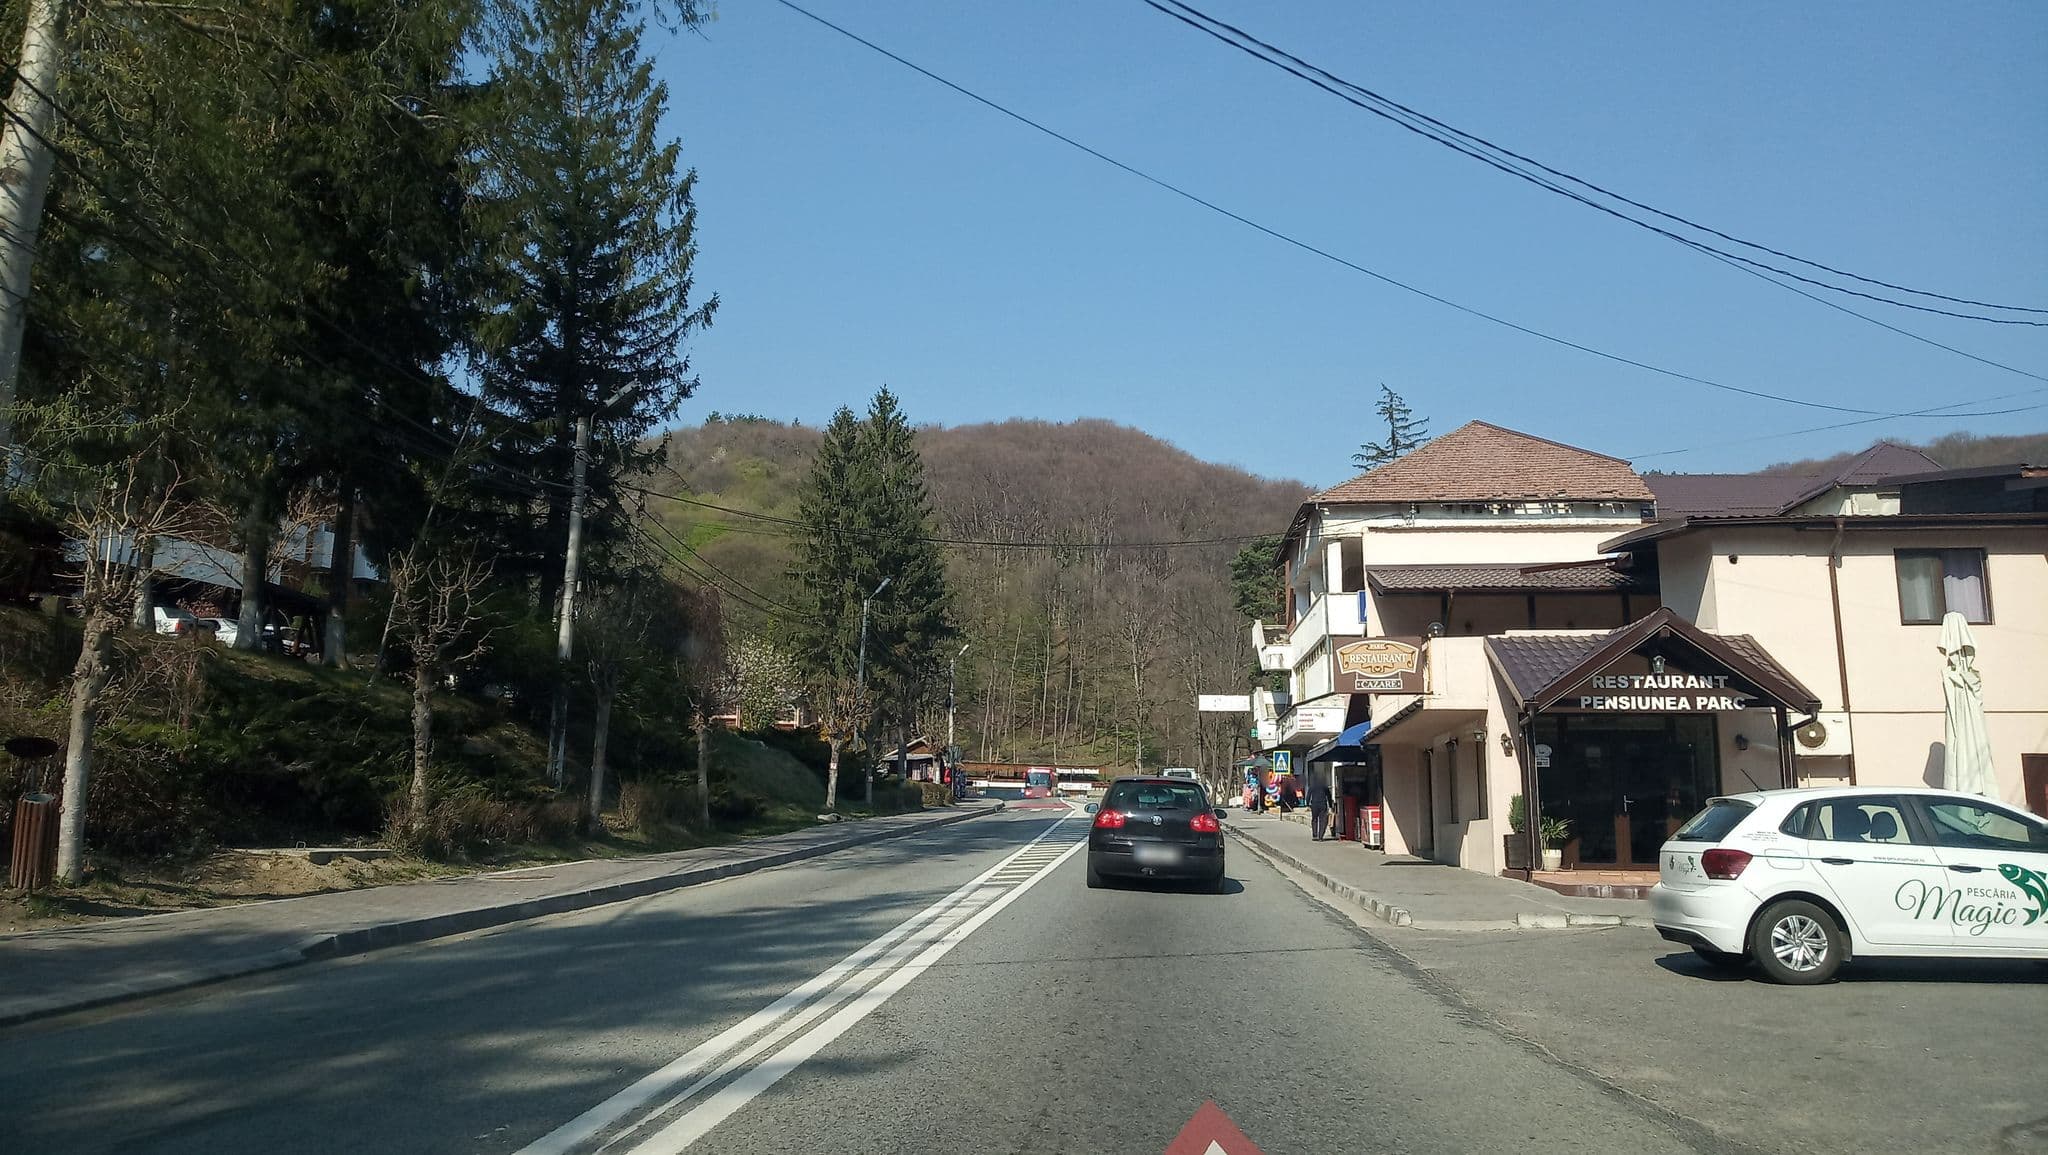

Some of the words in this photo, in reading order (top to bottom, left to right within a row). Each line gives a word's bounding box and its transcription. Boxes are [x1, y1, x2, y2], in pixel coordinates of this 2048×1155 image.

[1349, 653, 1408, 663] RESTAURANT
[1361, 680, 1396, 688] CAZARE
[1592, 674, 1729, 689] RESTAURANT
[1580, 696, 1691, 711] PENSIUNEA
[1696, 696, 1746, 711] PARC
[1967, 887, 2017, 900] PESCĂRIA
[1895, 879, 2017, 936] Magic
